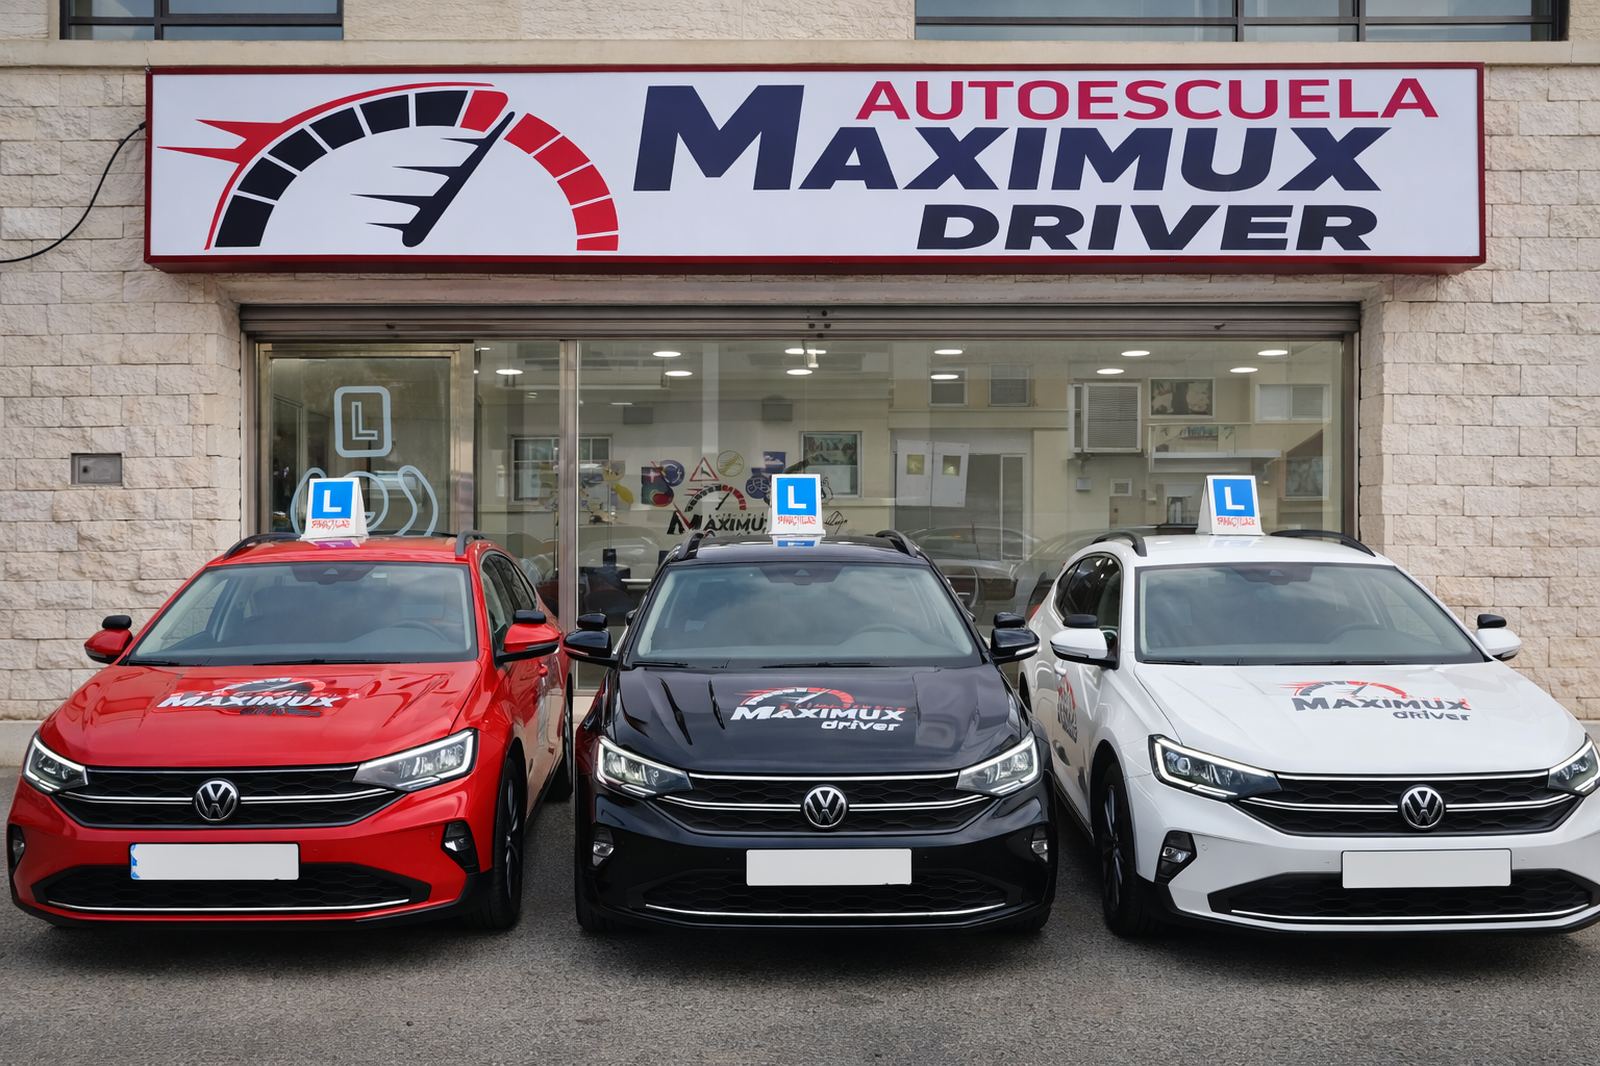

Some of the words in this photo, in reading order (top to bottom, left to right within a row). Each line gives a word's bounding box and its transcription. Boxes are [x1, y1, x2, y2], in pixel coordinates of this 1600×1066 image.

[855, 78, 1439, 121] AUTOESCUELA
[633, 85, 1390, 191] MAXIMUX
[916, 204, 1379, 251] DRIVER
[351, 400, 379, 441] L
[323, 490, 343, 512] L
[787, 485, 807, 509] L
[1223, 486, 1245, 510] L
[666, 510, 768, 535] MAXIMU
[156, 694, 342, 708] MAXIMUX
[730, 705, 907, 721] MAXIMUX
[1291, 697, 1472, 712] MAXIMUX
[820, 720, 901, 732] driver
[1393, 710, 1471, 721] driver
